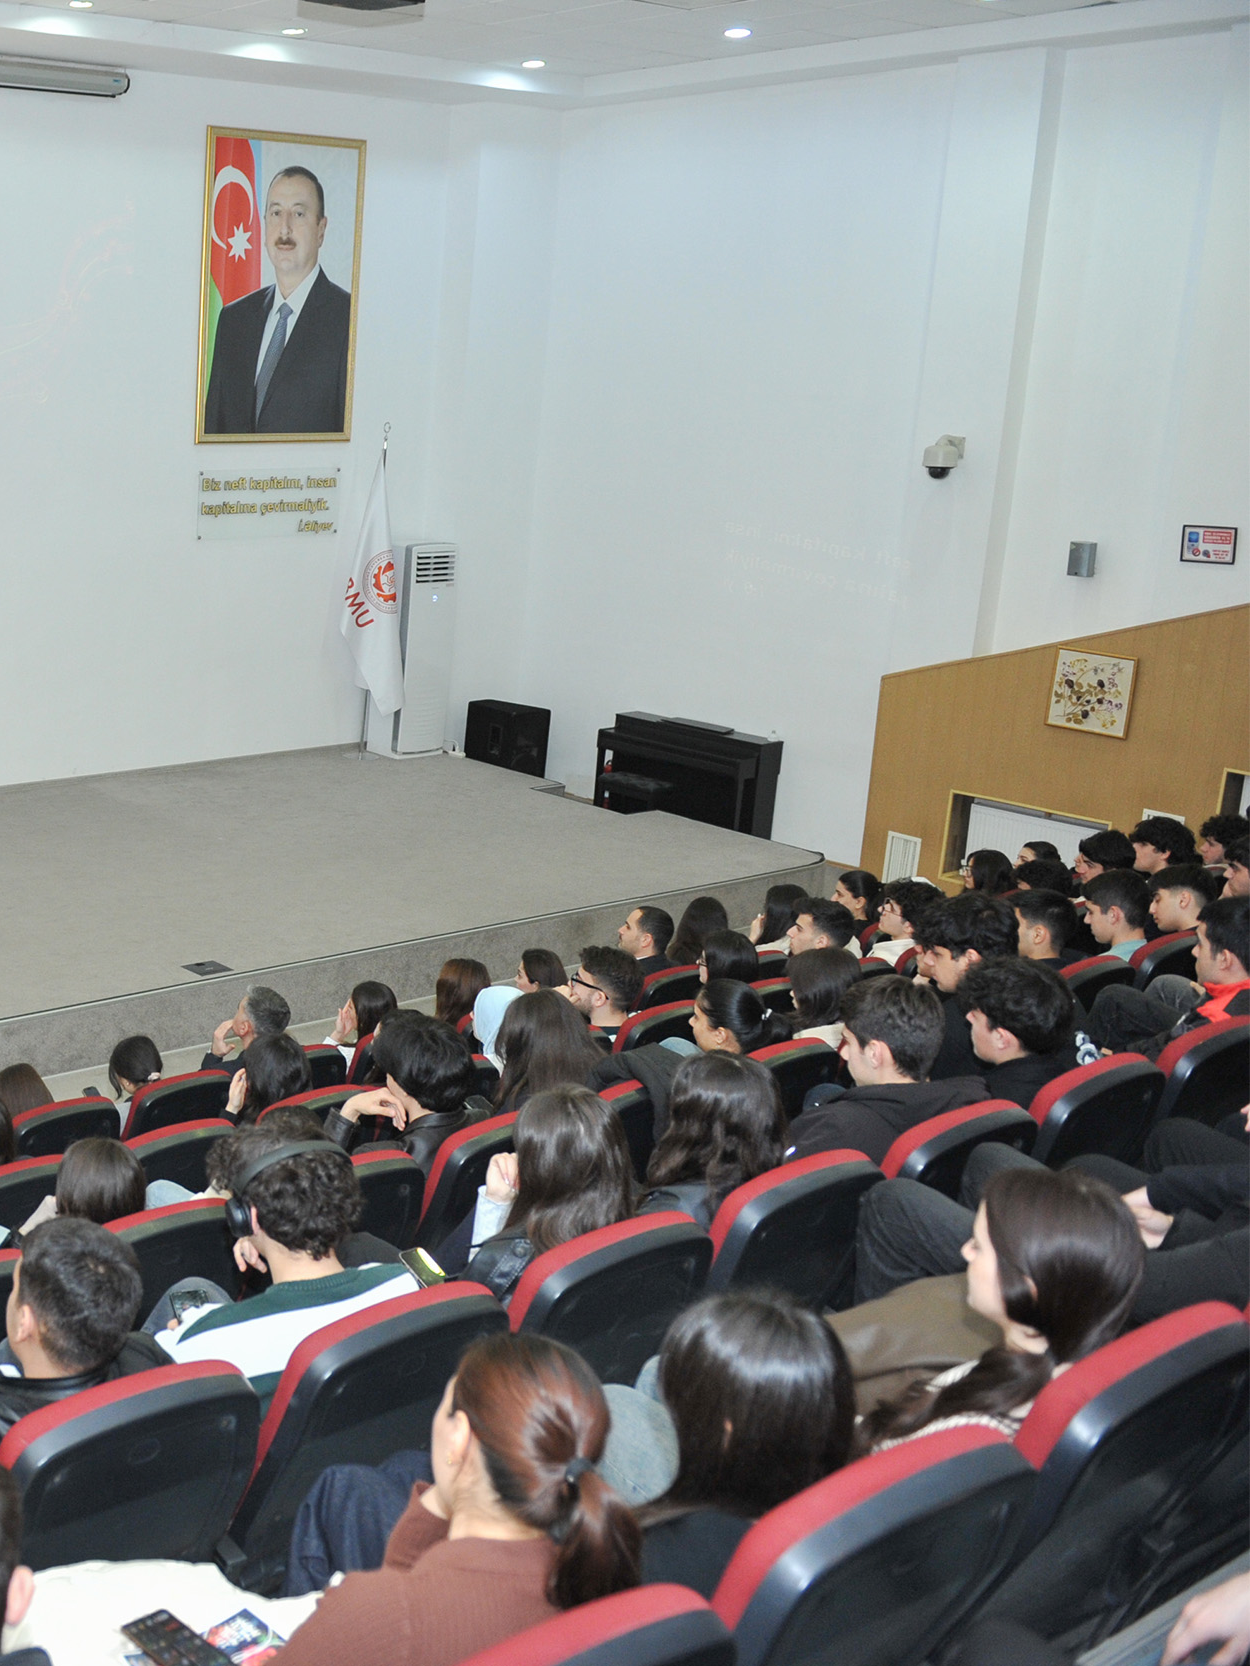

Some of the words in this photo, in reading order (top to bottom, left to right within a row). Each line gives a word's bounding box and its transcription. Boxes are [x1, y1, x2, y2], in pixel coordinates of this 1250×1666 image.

[202, 478, 221, 491] Biz
[224, 477, 247, 491] neft
[307, 476, 337, 489] insan
